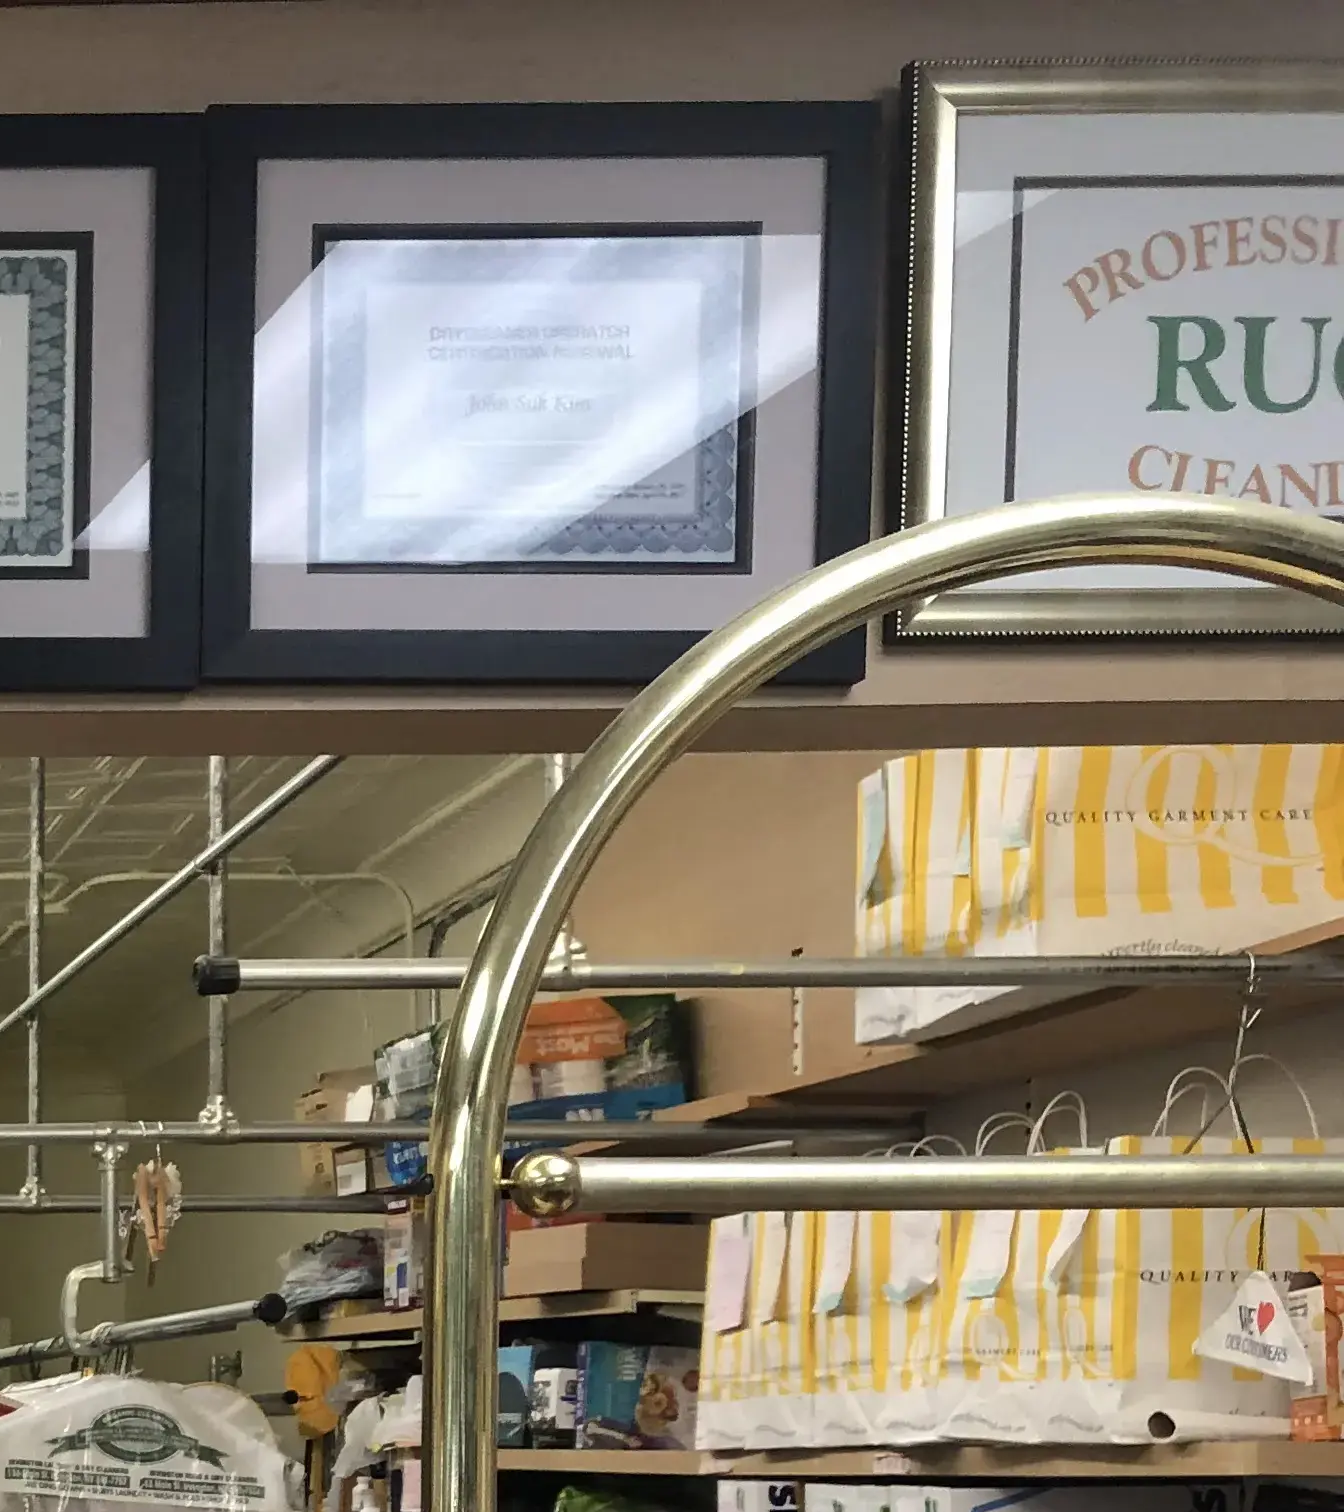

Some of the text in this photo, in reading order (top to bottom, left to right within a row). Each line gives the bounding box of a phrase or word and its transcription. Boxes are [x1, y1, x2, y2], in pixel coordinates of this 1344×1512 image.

[1063, 215, 1344, 322] PROFESSI
[1145, 316, 1344, 413] RU
[1046, 808, 1312, 826] QUALITY GARMENT CARE
[1140, 1270, 1240, 1285] QUALITY
